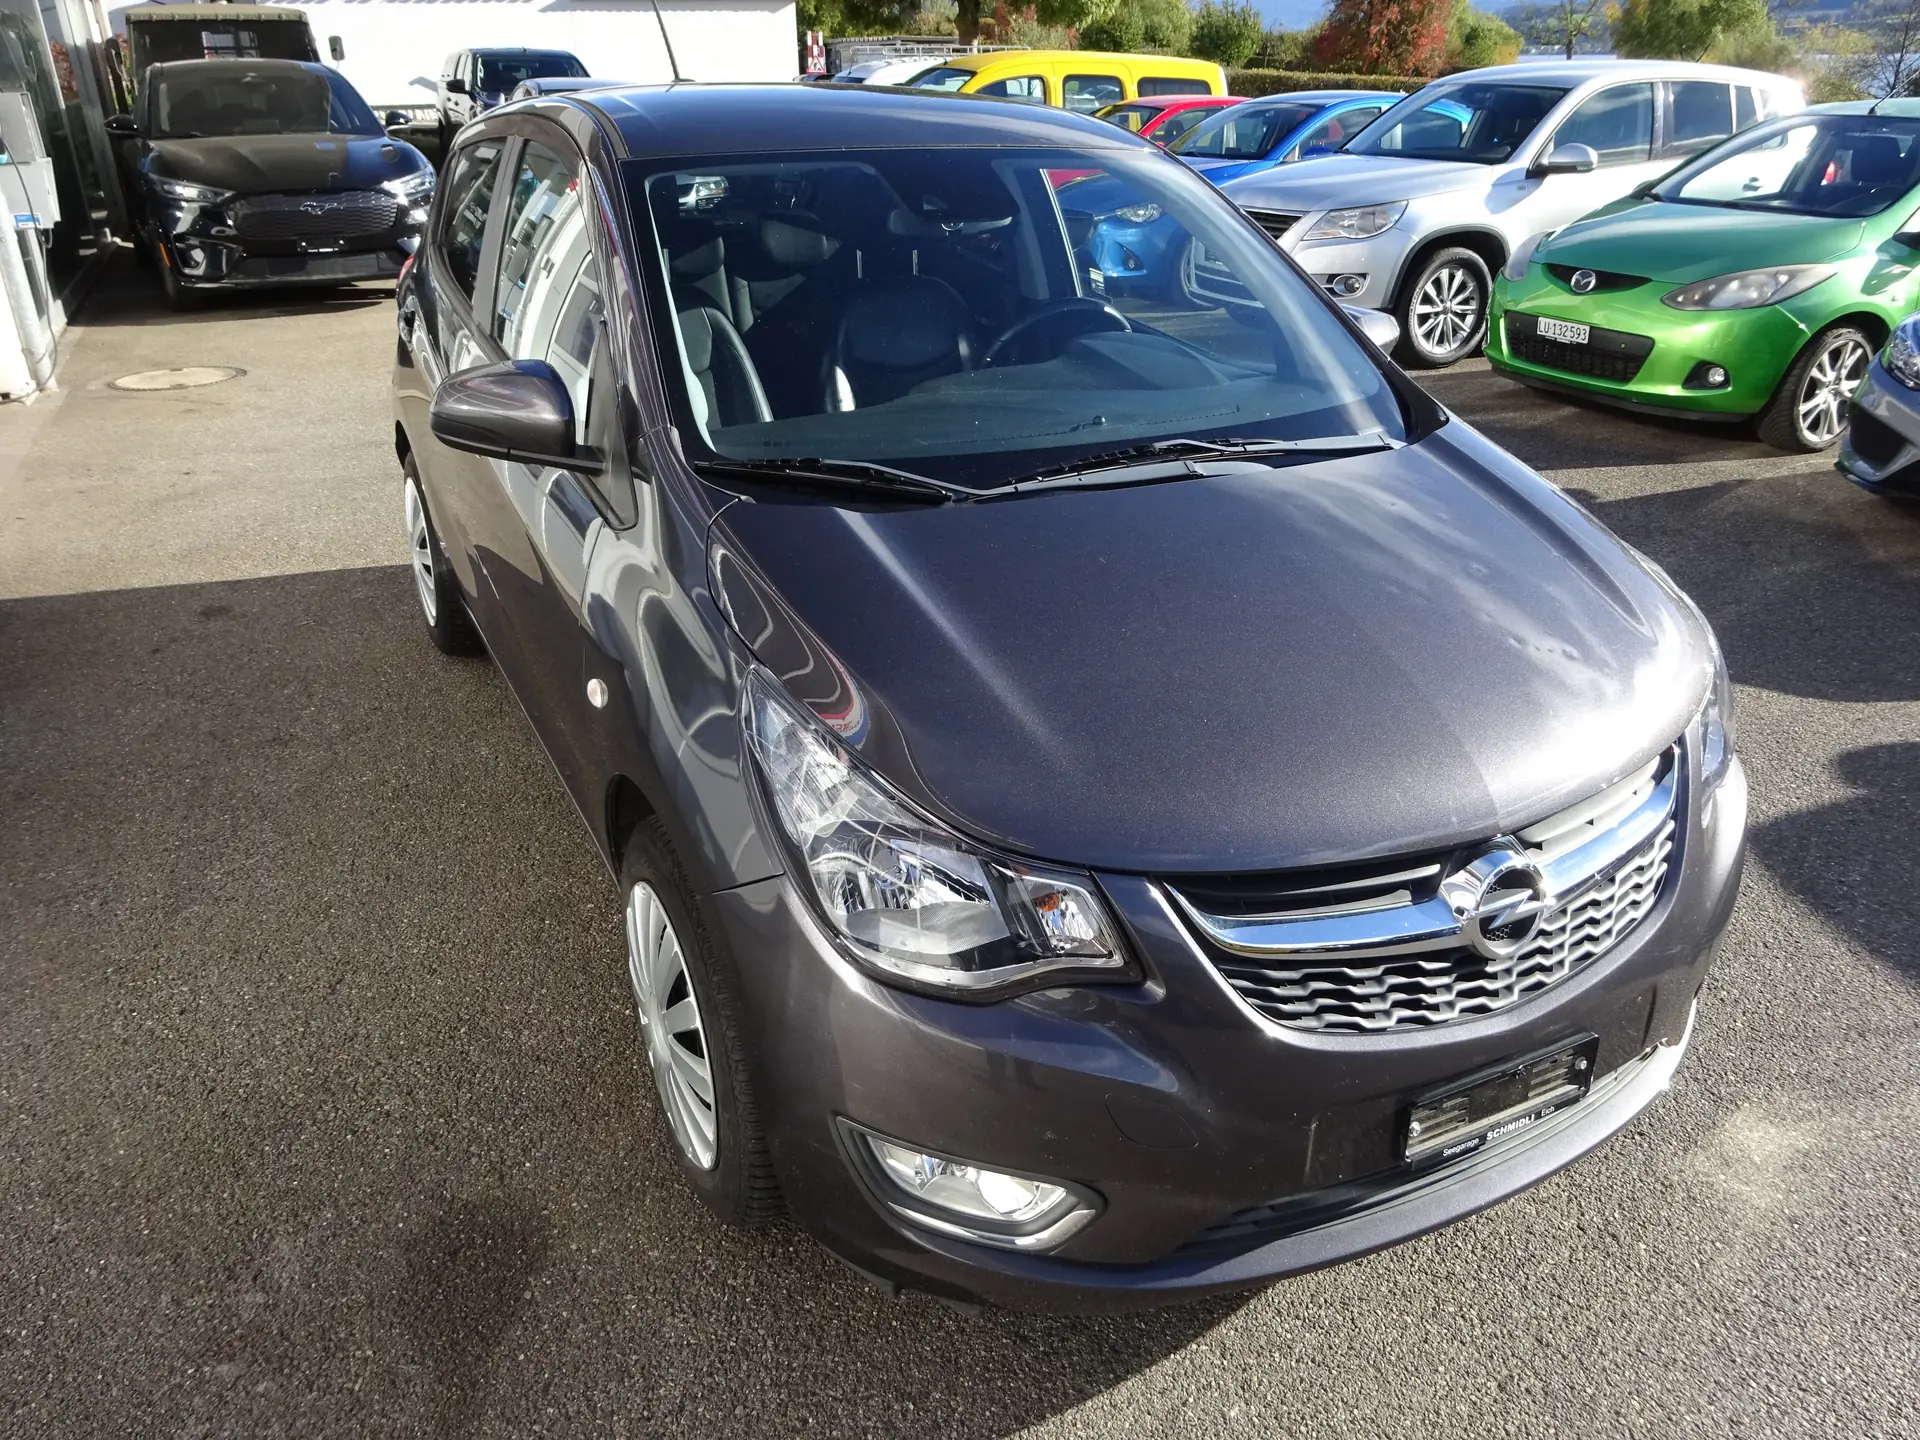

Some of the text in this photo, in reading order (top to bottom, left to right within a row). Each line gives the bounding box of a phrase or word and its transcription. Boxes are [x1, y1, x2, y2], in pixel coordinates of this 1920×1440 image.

[1442, 1106, 1555, 1156] Seegarage SCHMIDLI Eich
